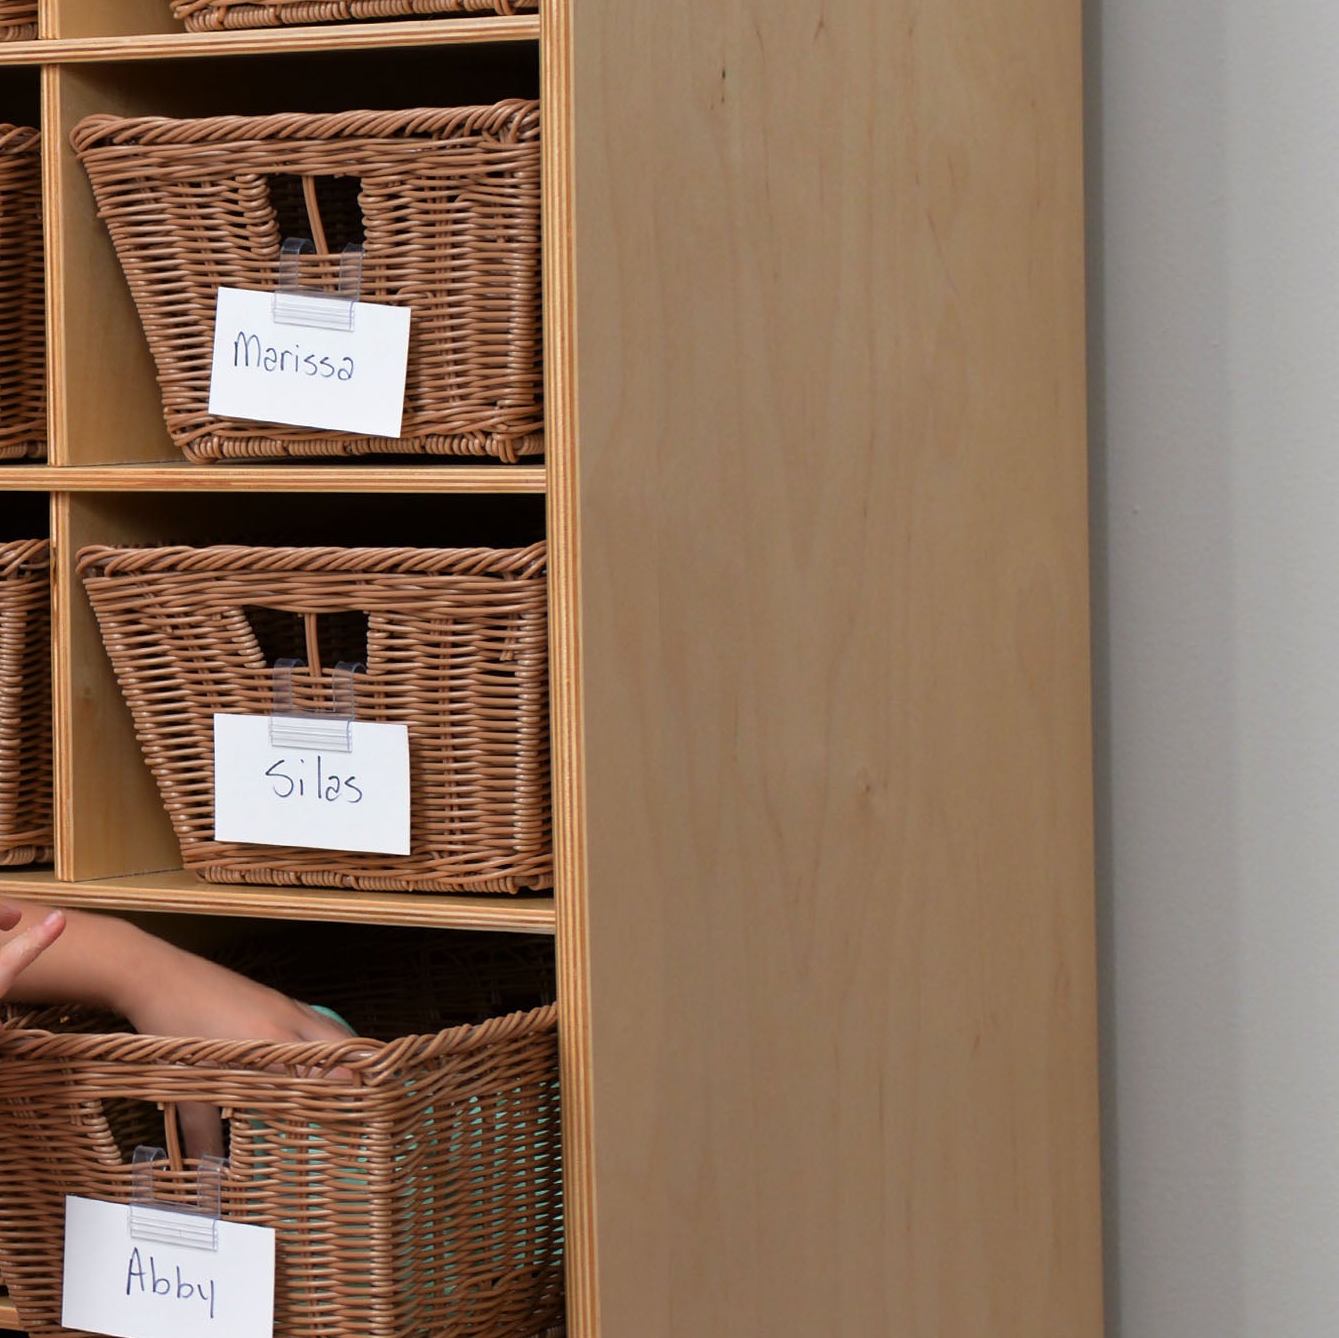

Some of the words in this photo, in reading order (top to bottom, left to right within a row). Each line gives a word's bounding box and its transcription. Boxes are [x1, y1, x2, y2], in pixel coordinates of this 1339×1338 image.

[233, 332, 355, 381] Marissa
[264, 756, 363, 804] Silas
[125, 1247, 216, 1319] Abby
